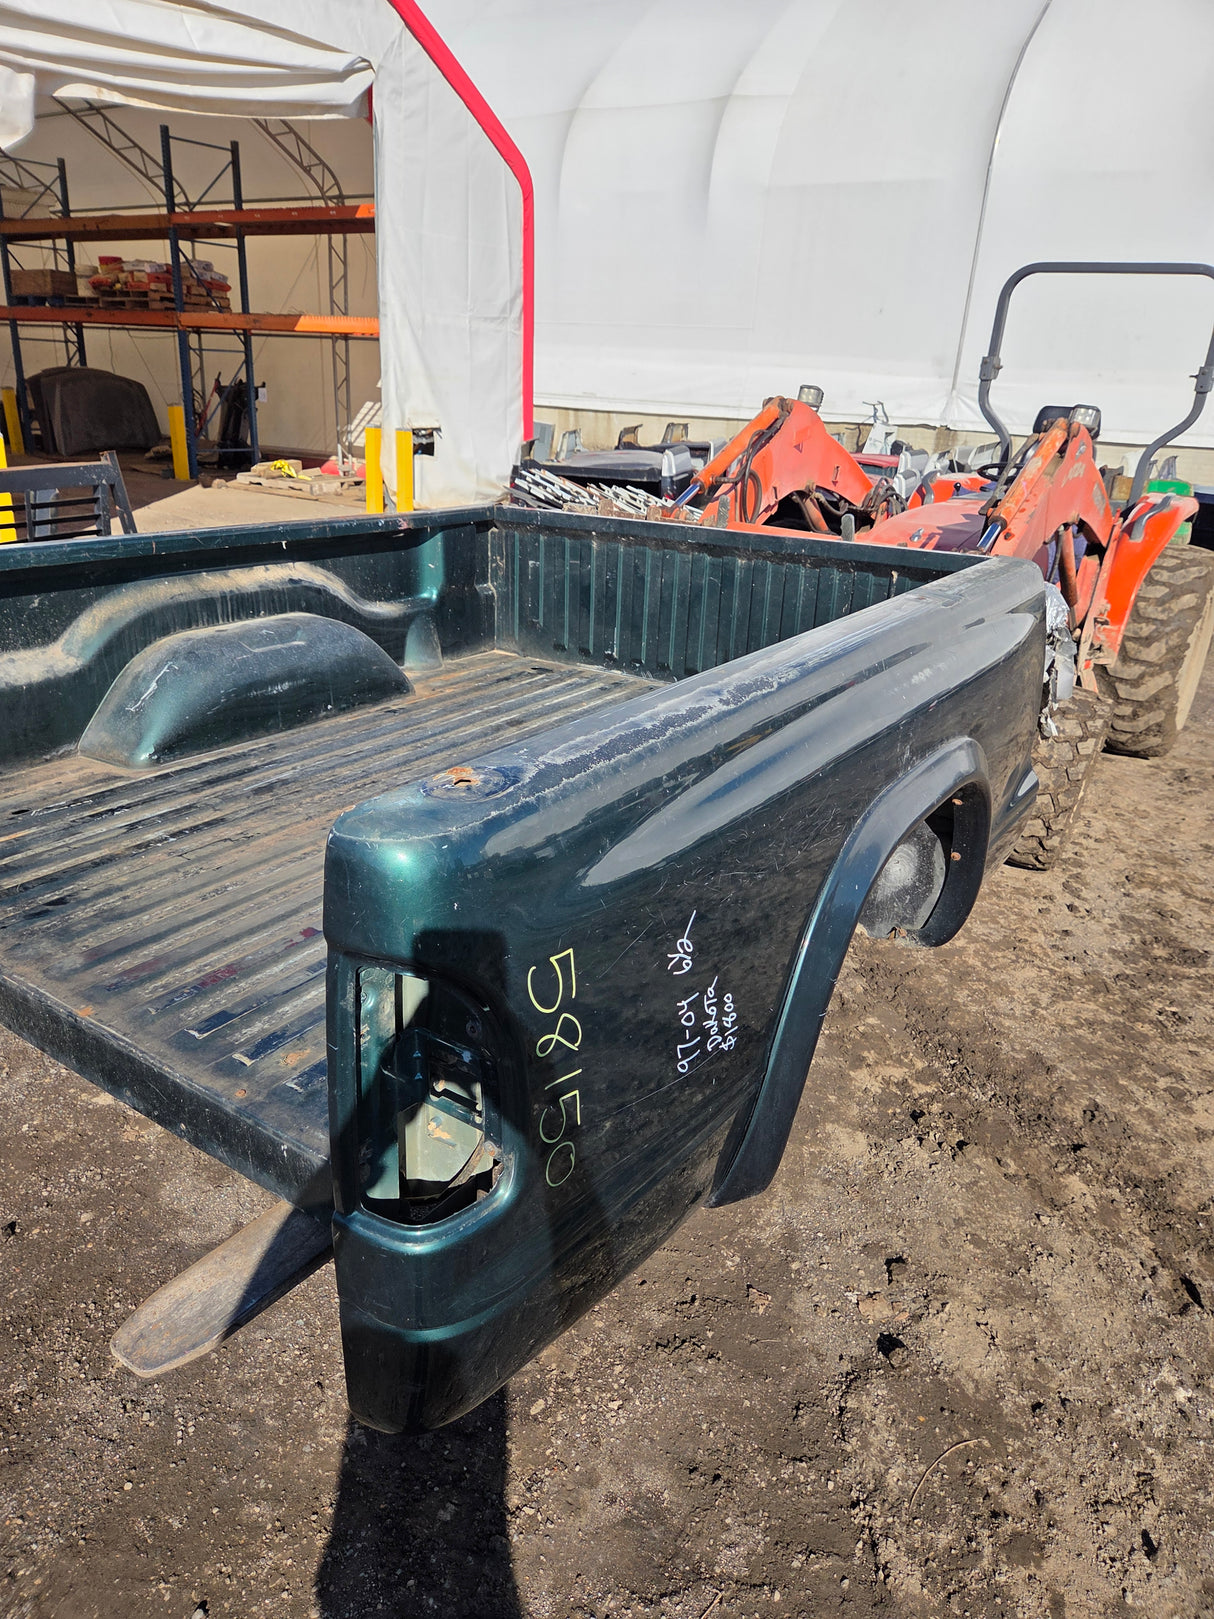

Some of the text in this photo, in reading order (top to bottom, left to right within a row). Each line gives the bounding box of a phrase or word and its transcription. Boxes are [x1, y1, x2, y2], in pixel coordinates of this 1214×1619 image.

[677, 992, 700, 1073] 97-04
[719, 993, 738, 1051] $1800
[528, 947, 583, 1187] 58150
